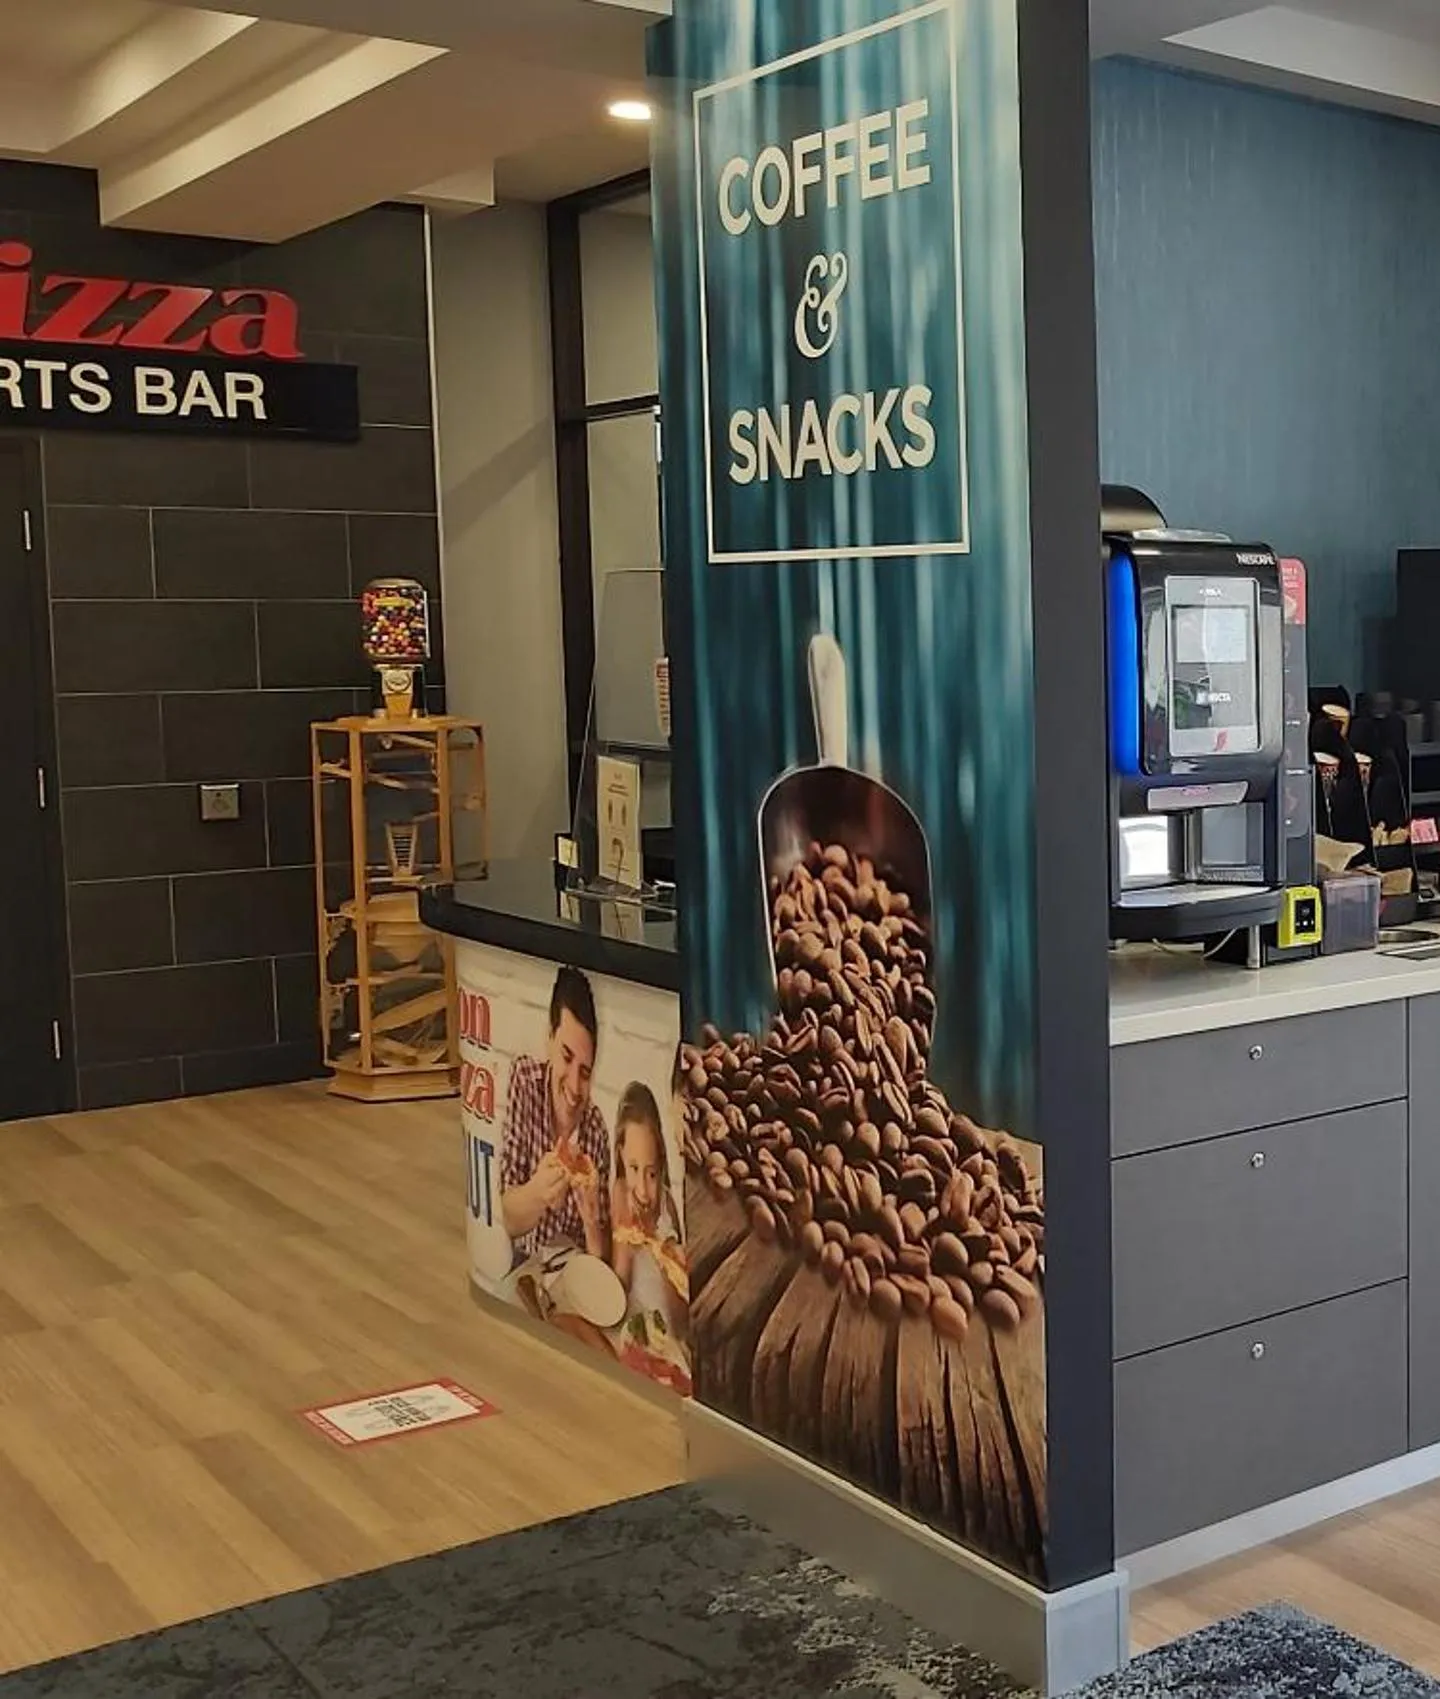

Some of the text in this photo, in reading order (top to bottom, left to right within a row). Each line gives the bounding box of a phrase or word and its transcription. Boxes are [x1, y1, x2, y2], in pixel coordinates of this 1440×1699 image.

[719, 98, 931, 236] COFFEE
[0, 241, 304, 359] izza
[795, 251, 848, 358] &
[133, 365, 267, 420] BAR
[728, 384, 937, 485] SNACKS
